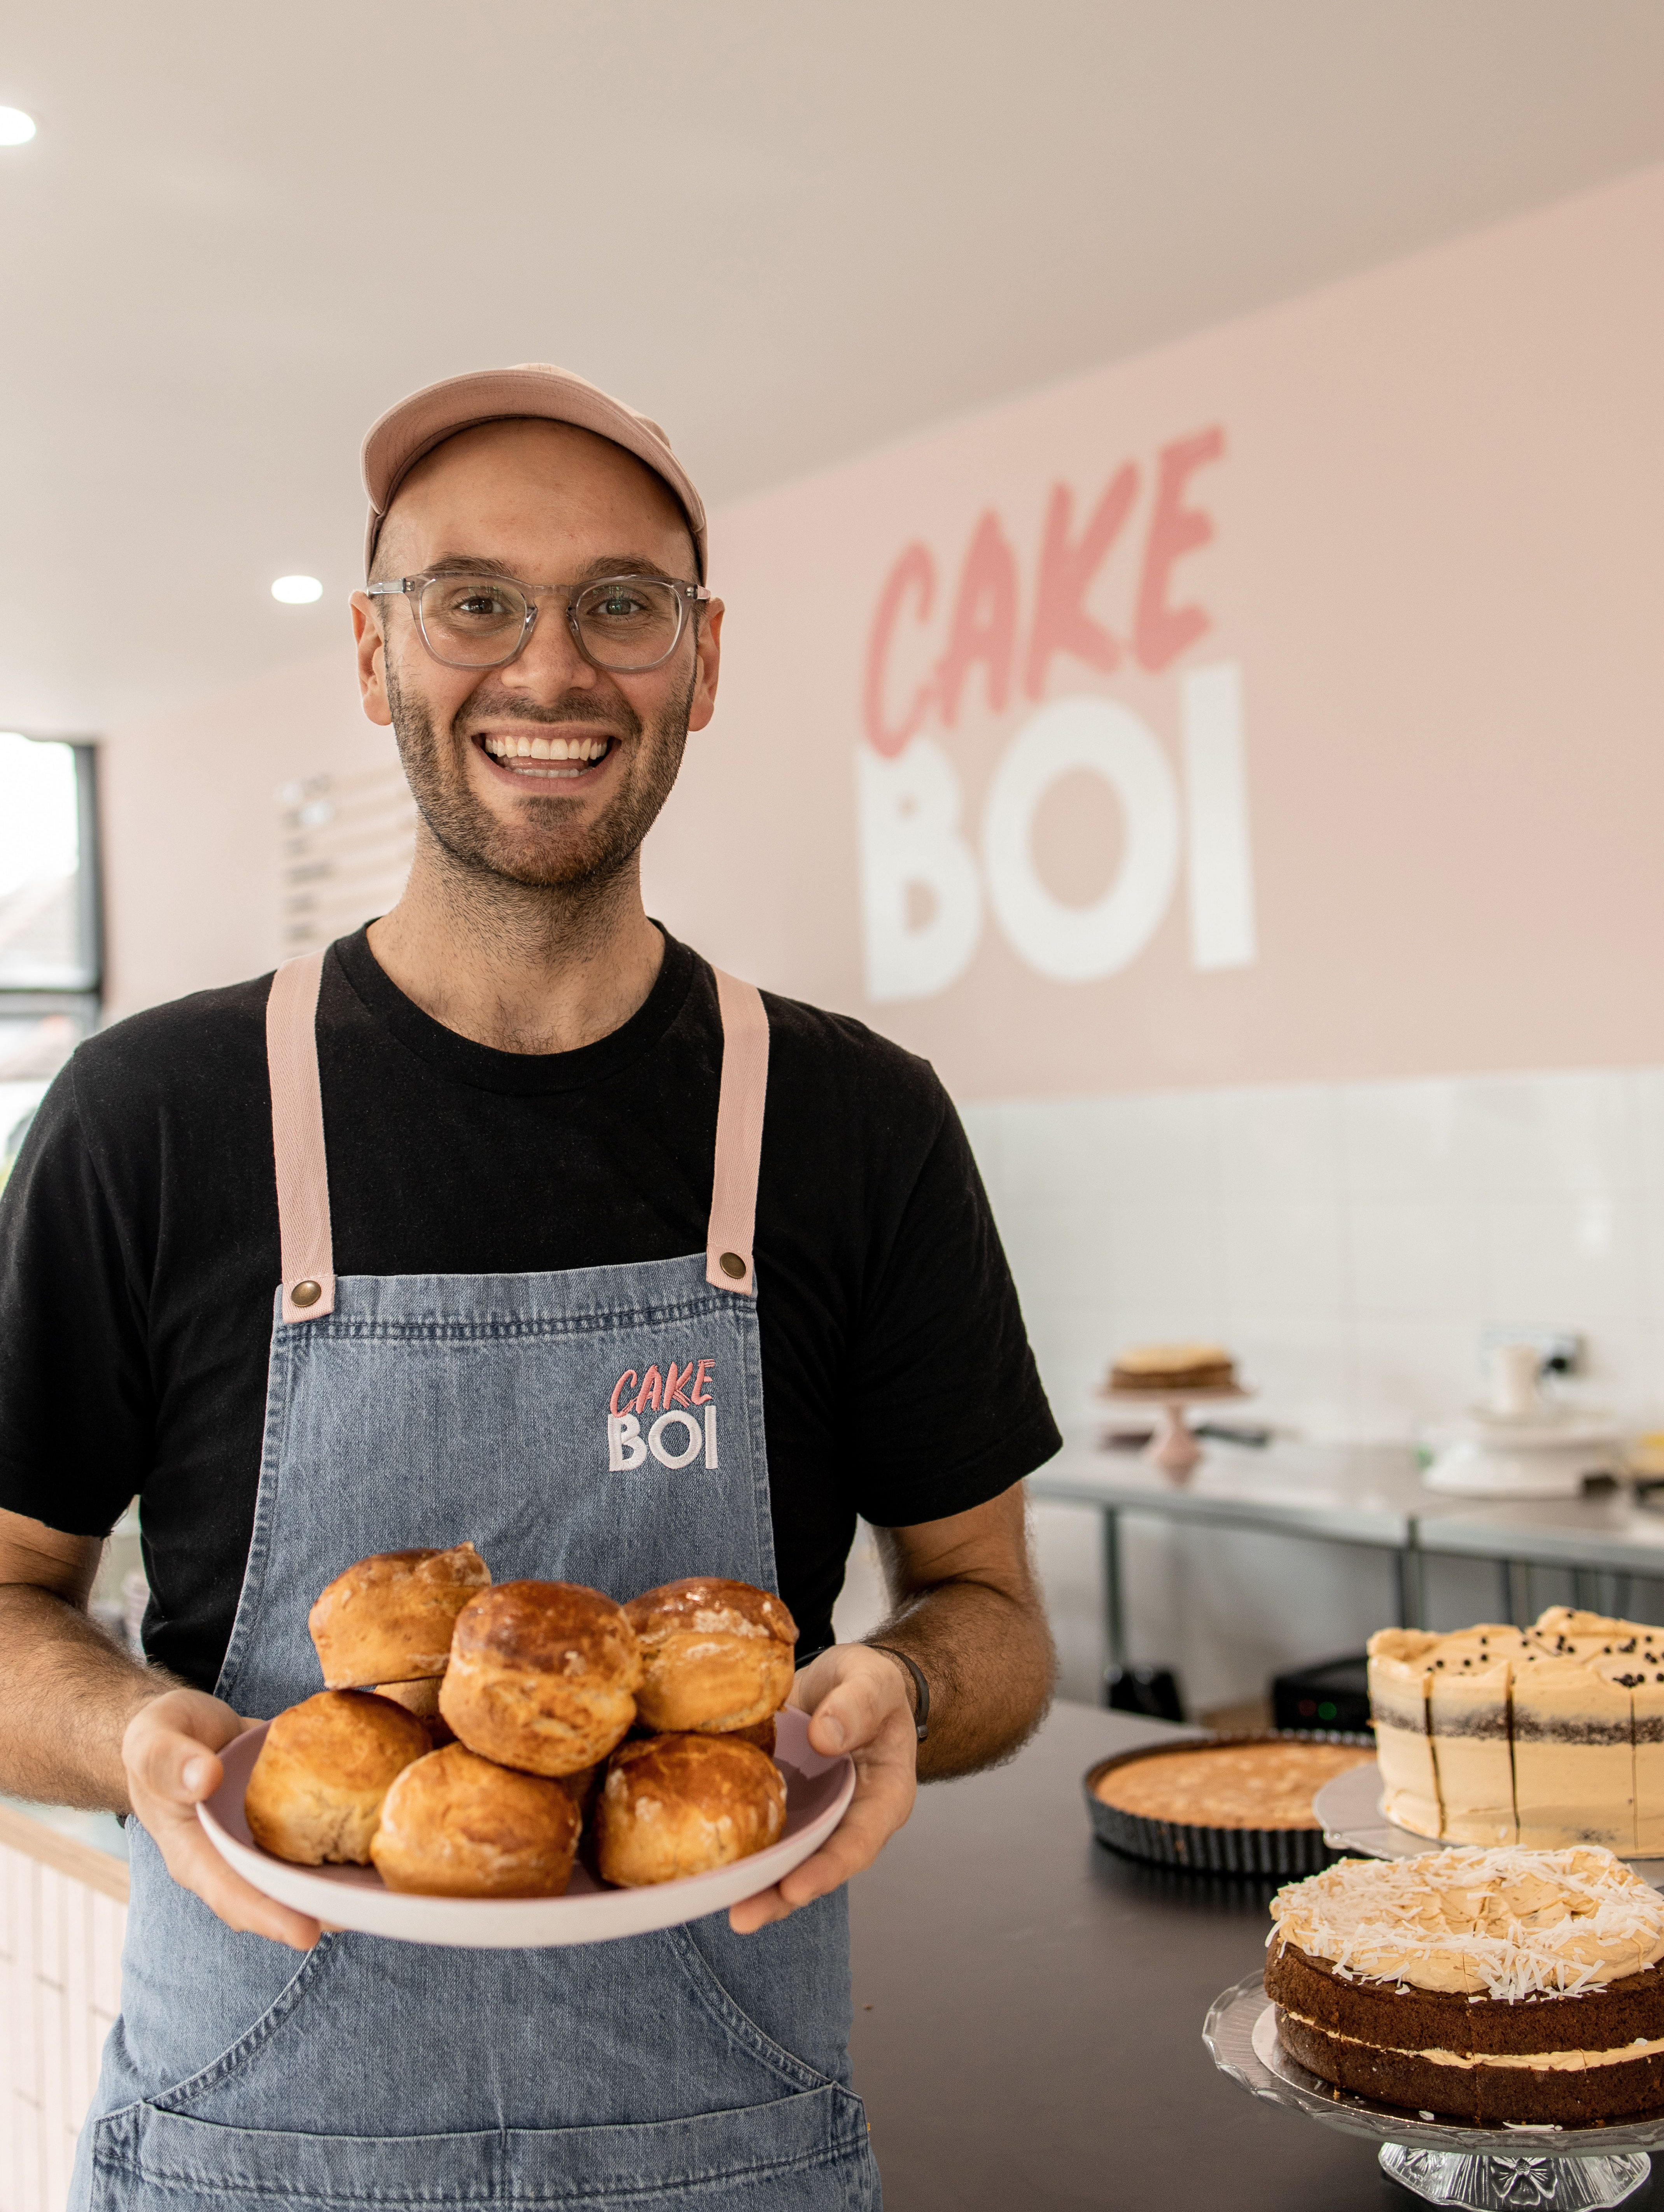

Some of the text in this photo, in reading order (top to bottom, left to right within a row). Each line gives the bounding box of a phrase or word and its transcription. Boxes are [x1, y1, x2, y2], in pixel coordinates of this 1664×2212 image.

[863, 426, 1226, 758] CAKE
[859, 664, 1254, 1002] BOI
[607, 1405, 719, 1472] BOI
[610, 1359, 716, 1418] CAKE
